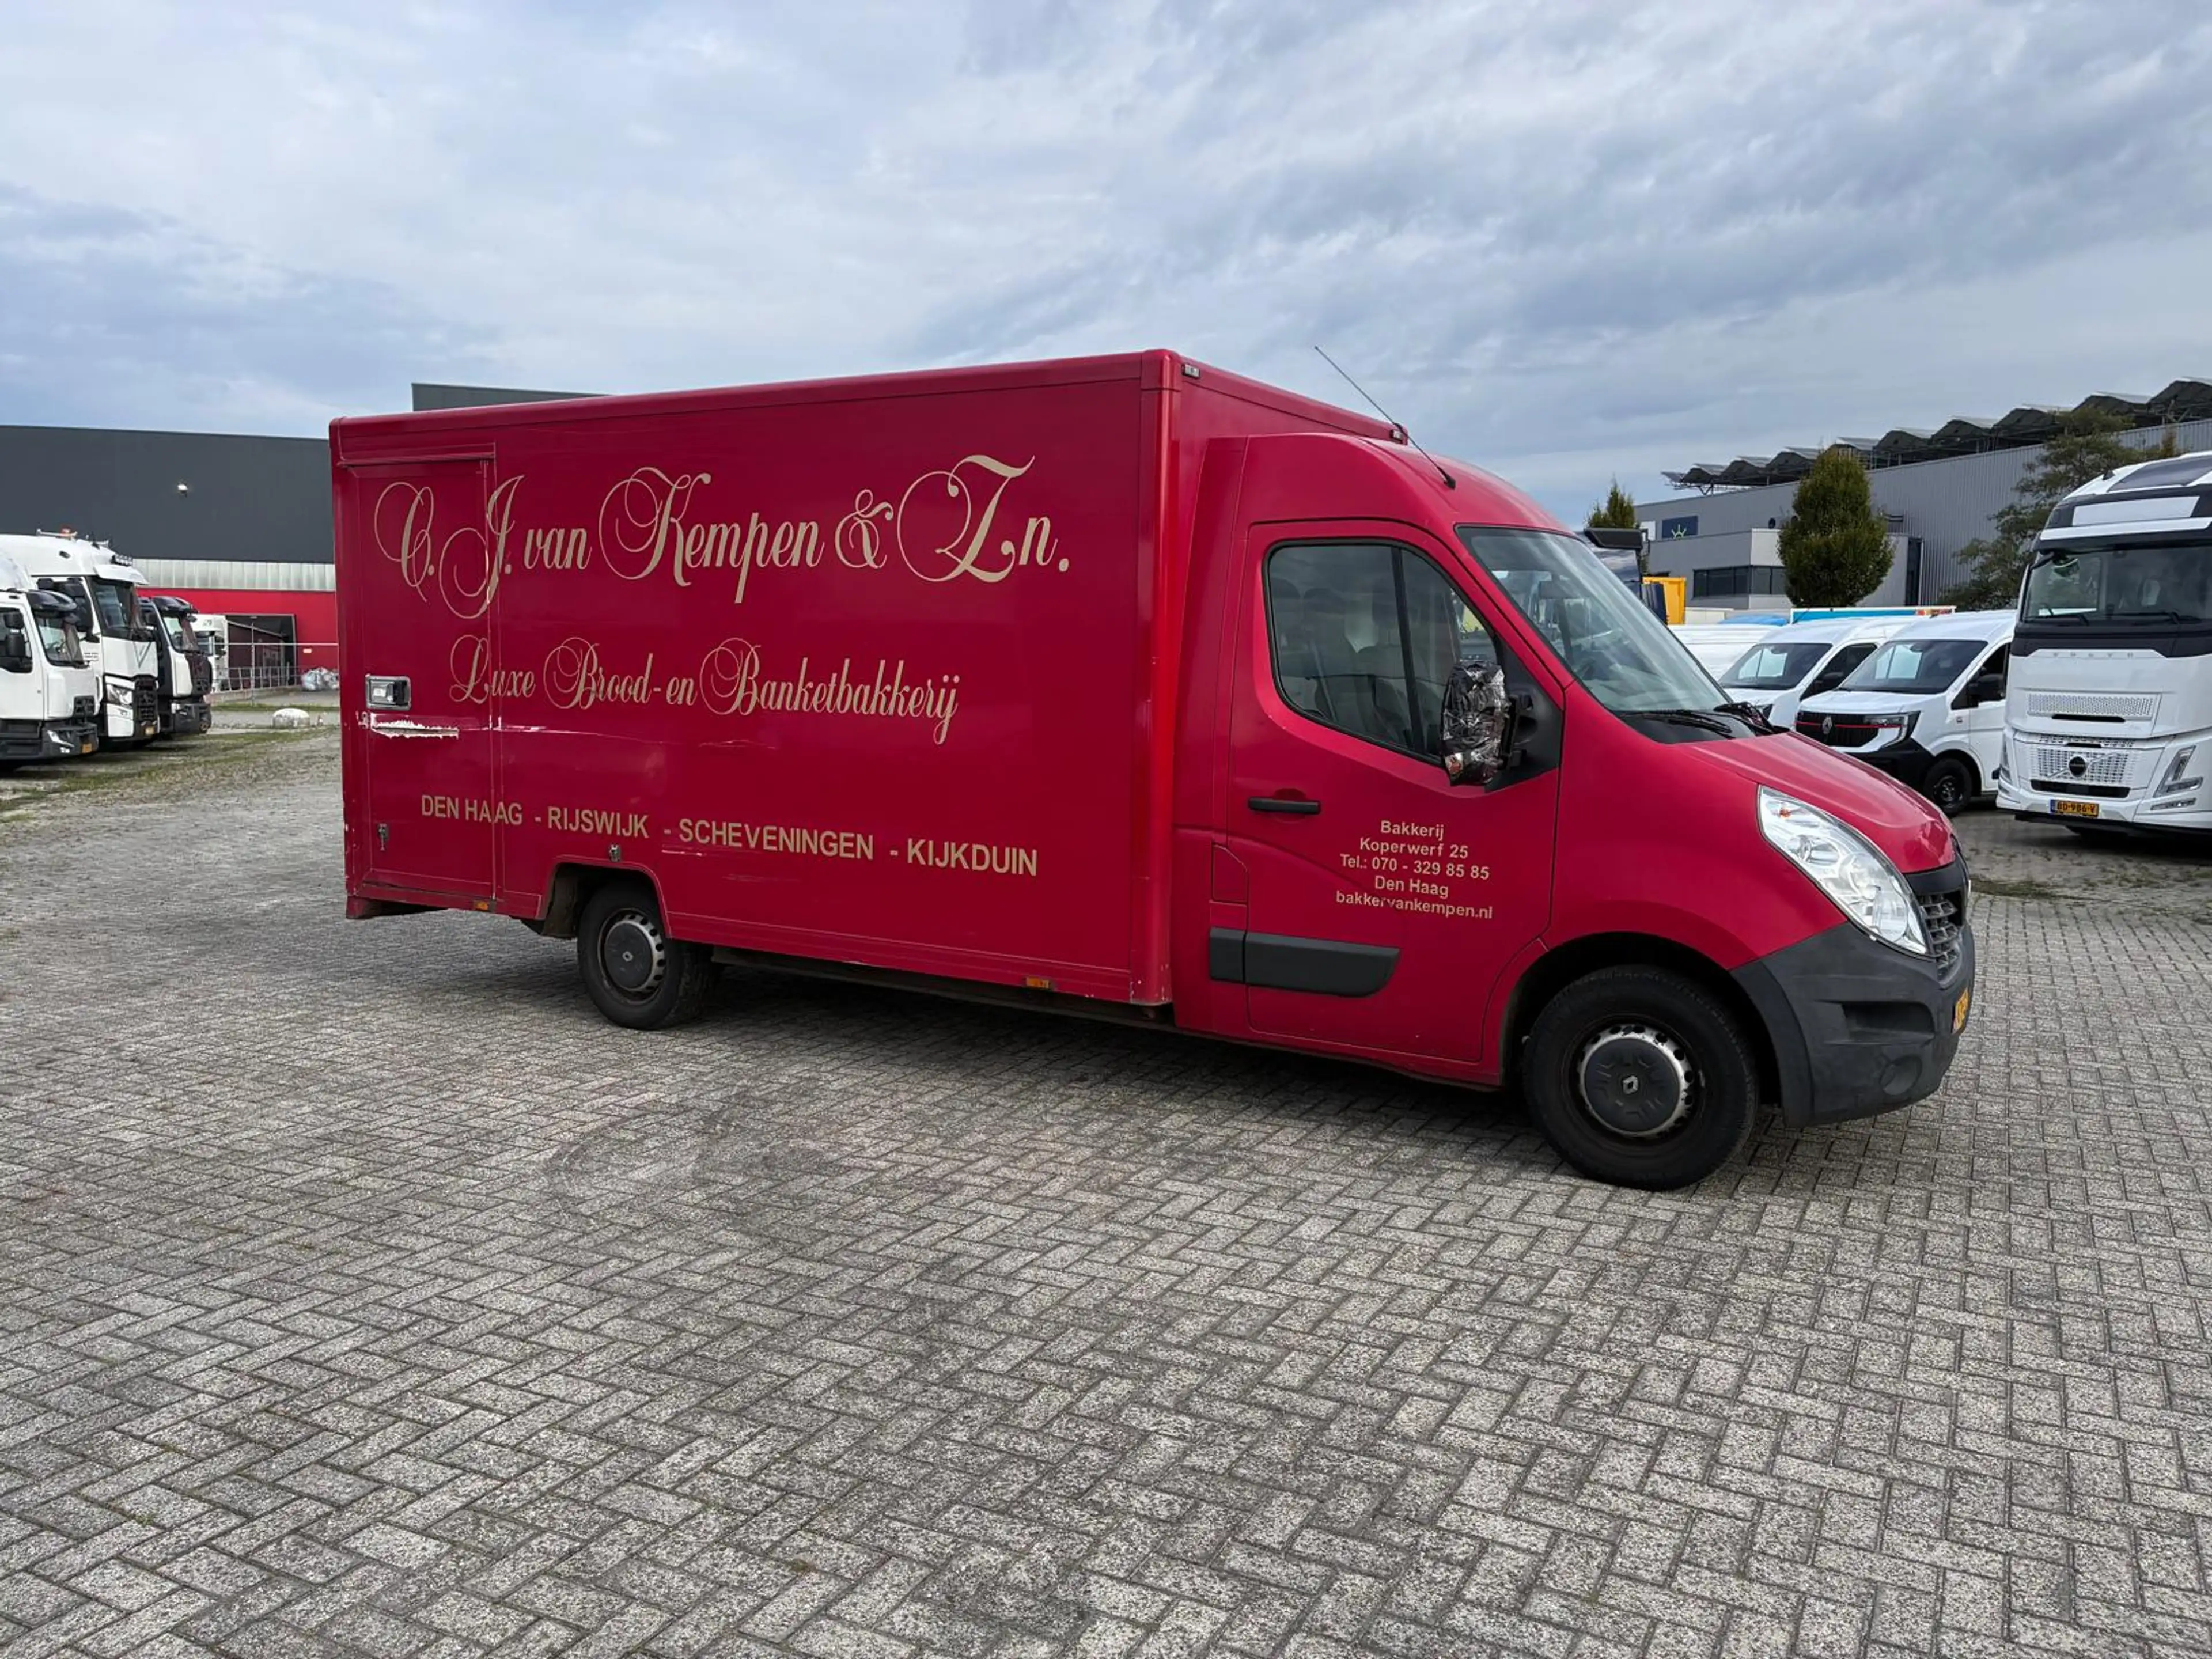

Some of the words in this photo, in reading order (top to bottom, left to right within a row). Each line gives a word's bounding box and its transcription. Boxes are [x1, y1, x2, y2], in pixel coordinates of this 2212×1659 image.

[524, 528, 592, 570] van
[599, 467, 825, 604] Kempen
[449, 635, 536, 704] Luxe
[699, 638, 960, 745] Banketbakkerij
[422, 794, 459, 819] DEN
[465, 798, 522, 825] HAAG
[548, 806, 649, 839] RIJSWIJK
[679, 817, 873, 861] SCHEVENINGEN
[907, 838, 1037, 877] KIJKDUIN
[1381, 820, 1444, 841] Bakkerij
[1360, 837, 1444, 857] Koperwerf
[1449, 844, 1468, 859] 25
[1340, 854, 1367, 869] Tel.:
[1372, 857, 1397, 872] 070
[1414, 861, 1441, 875] 329
[1446, 863, 1465, 877] 85
[1470, 865, 1490, 880] 85
[1375, 875, 1404, 892] Den
[1410, 878, 1449, 899] Haag
